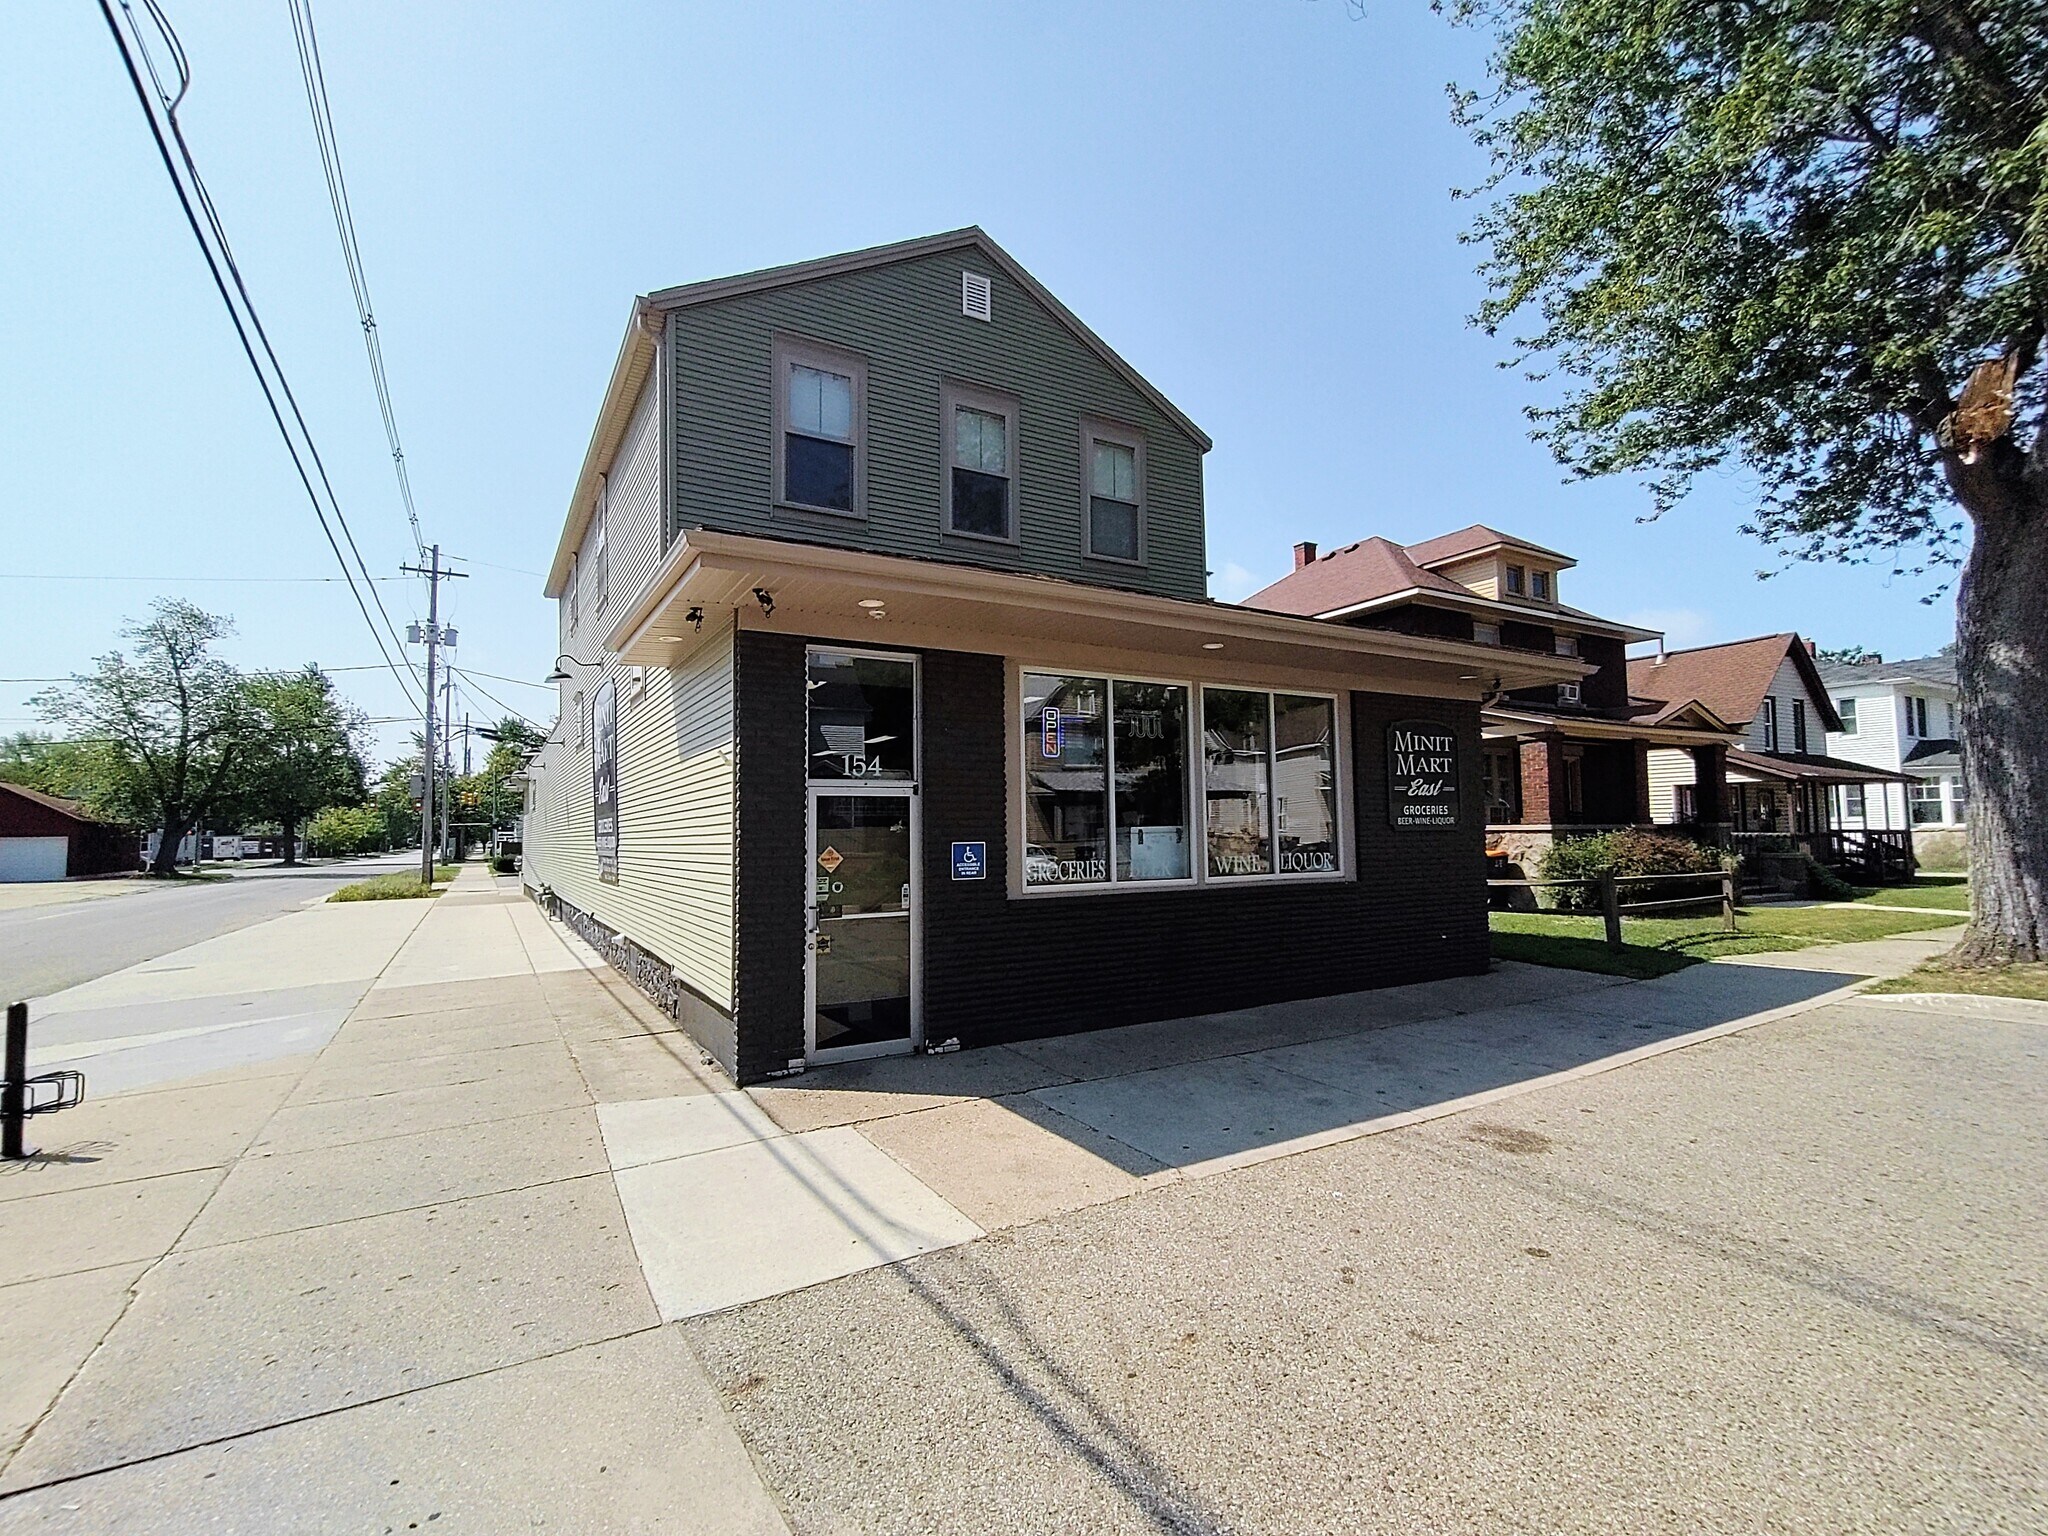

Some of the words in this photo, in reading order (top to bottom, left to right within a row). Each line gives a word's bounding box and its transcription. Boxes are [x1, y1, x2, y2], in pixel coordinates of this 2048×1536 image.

[1045, 710, 1057, 754] OPEN
[1394, 731, 1453, 752] MINIT
[841, 754, 883, 777] 154
[1396, 754, 1453, 776] MART
[1407, 779, 1444, 797] East
[1403, 805, 1449, 816] GROCERIES
[1026, 859, 1107, 882] GROCERIES
[1214, 854, 1262, 874] WINE
[1280, 852, 1334, 872] LIQUOR
